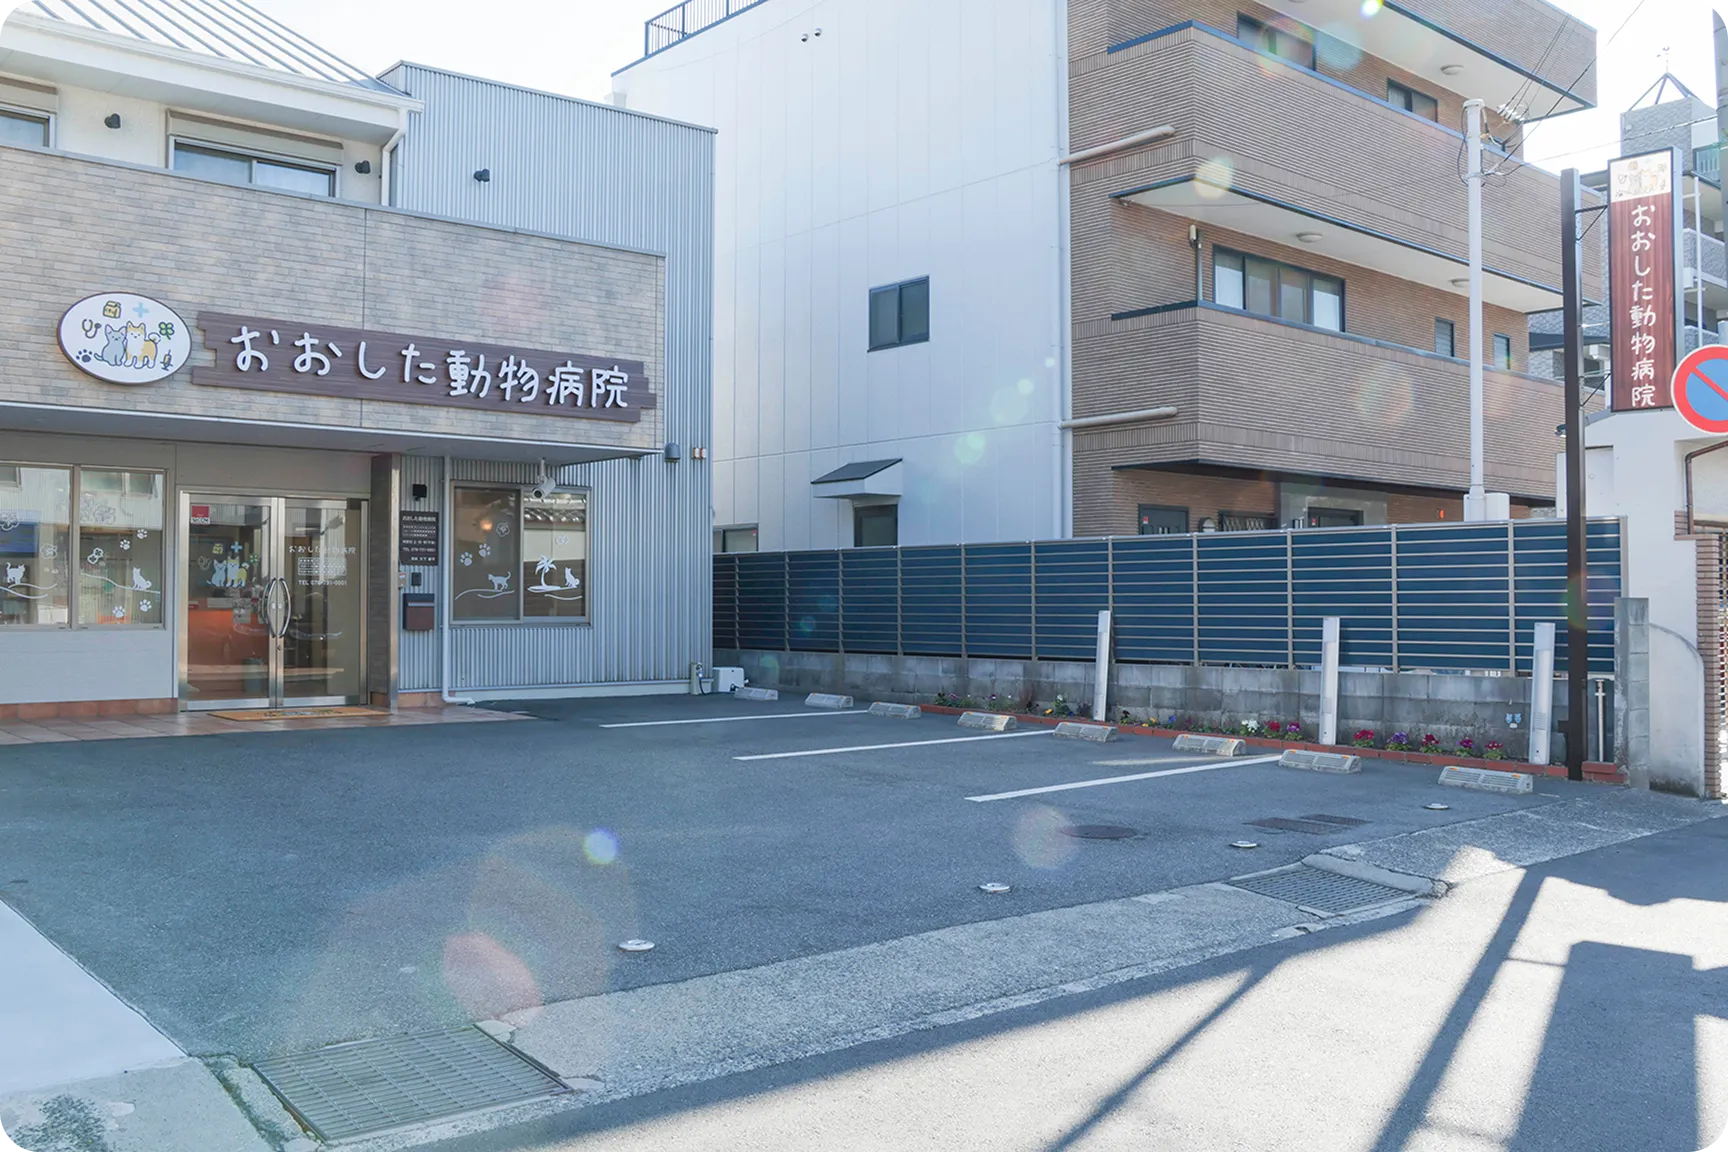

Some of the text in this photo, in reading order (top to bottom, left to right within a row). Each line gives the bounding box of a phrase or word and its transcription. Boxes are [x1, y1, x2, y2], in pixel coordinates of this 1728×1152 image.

[230, 325, 630, 409] おおした動物病院
[1629, 204, 1657, 407] おおした動物病院
